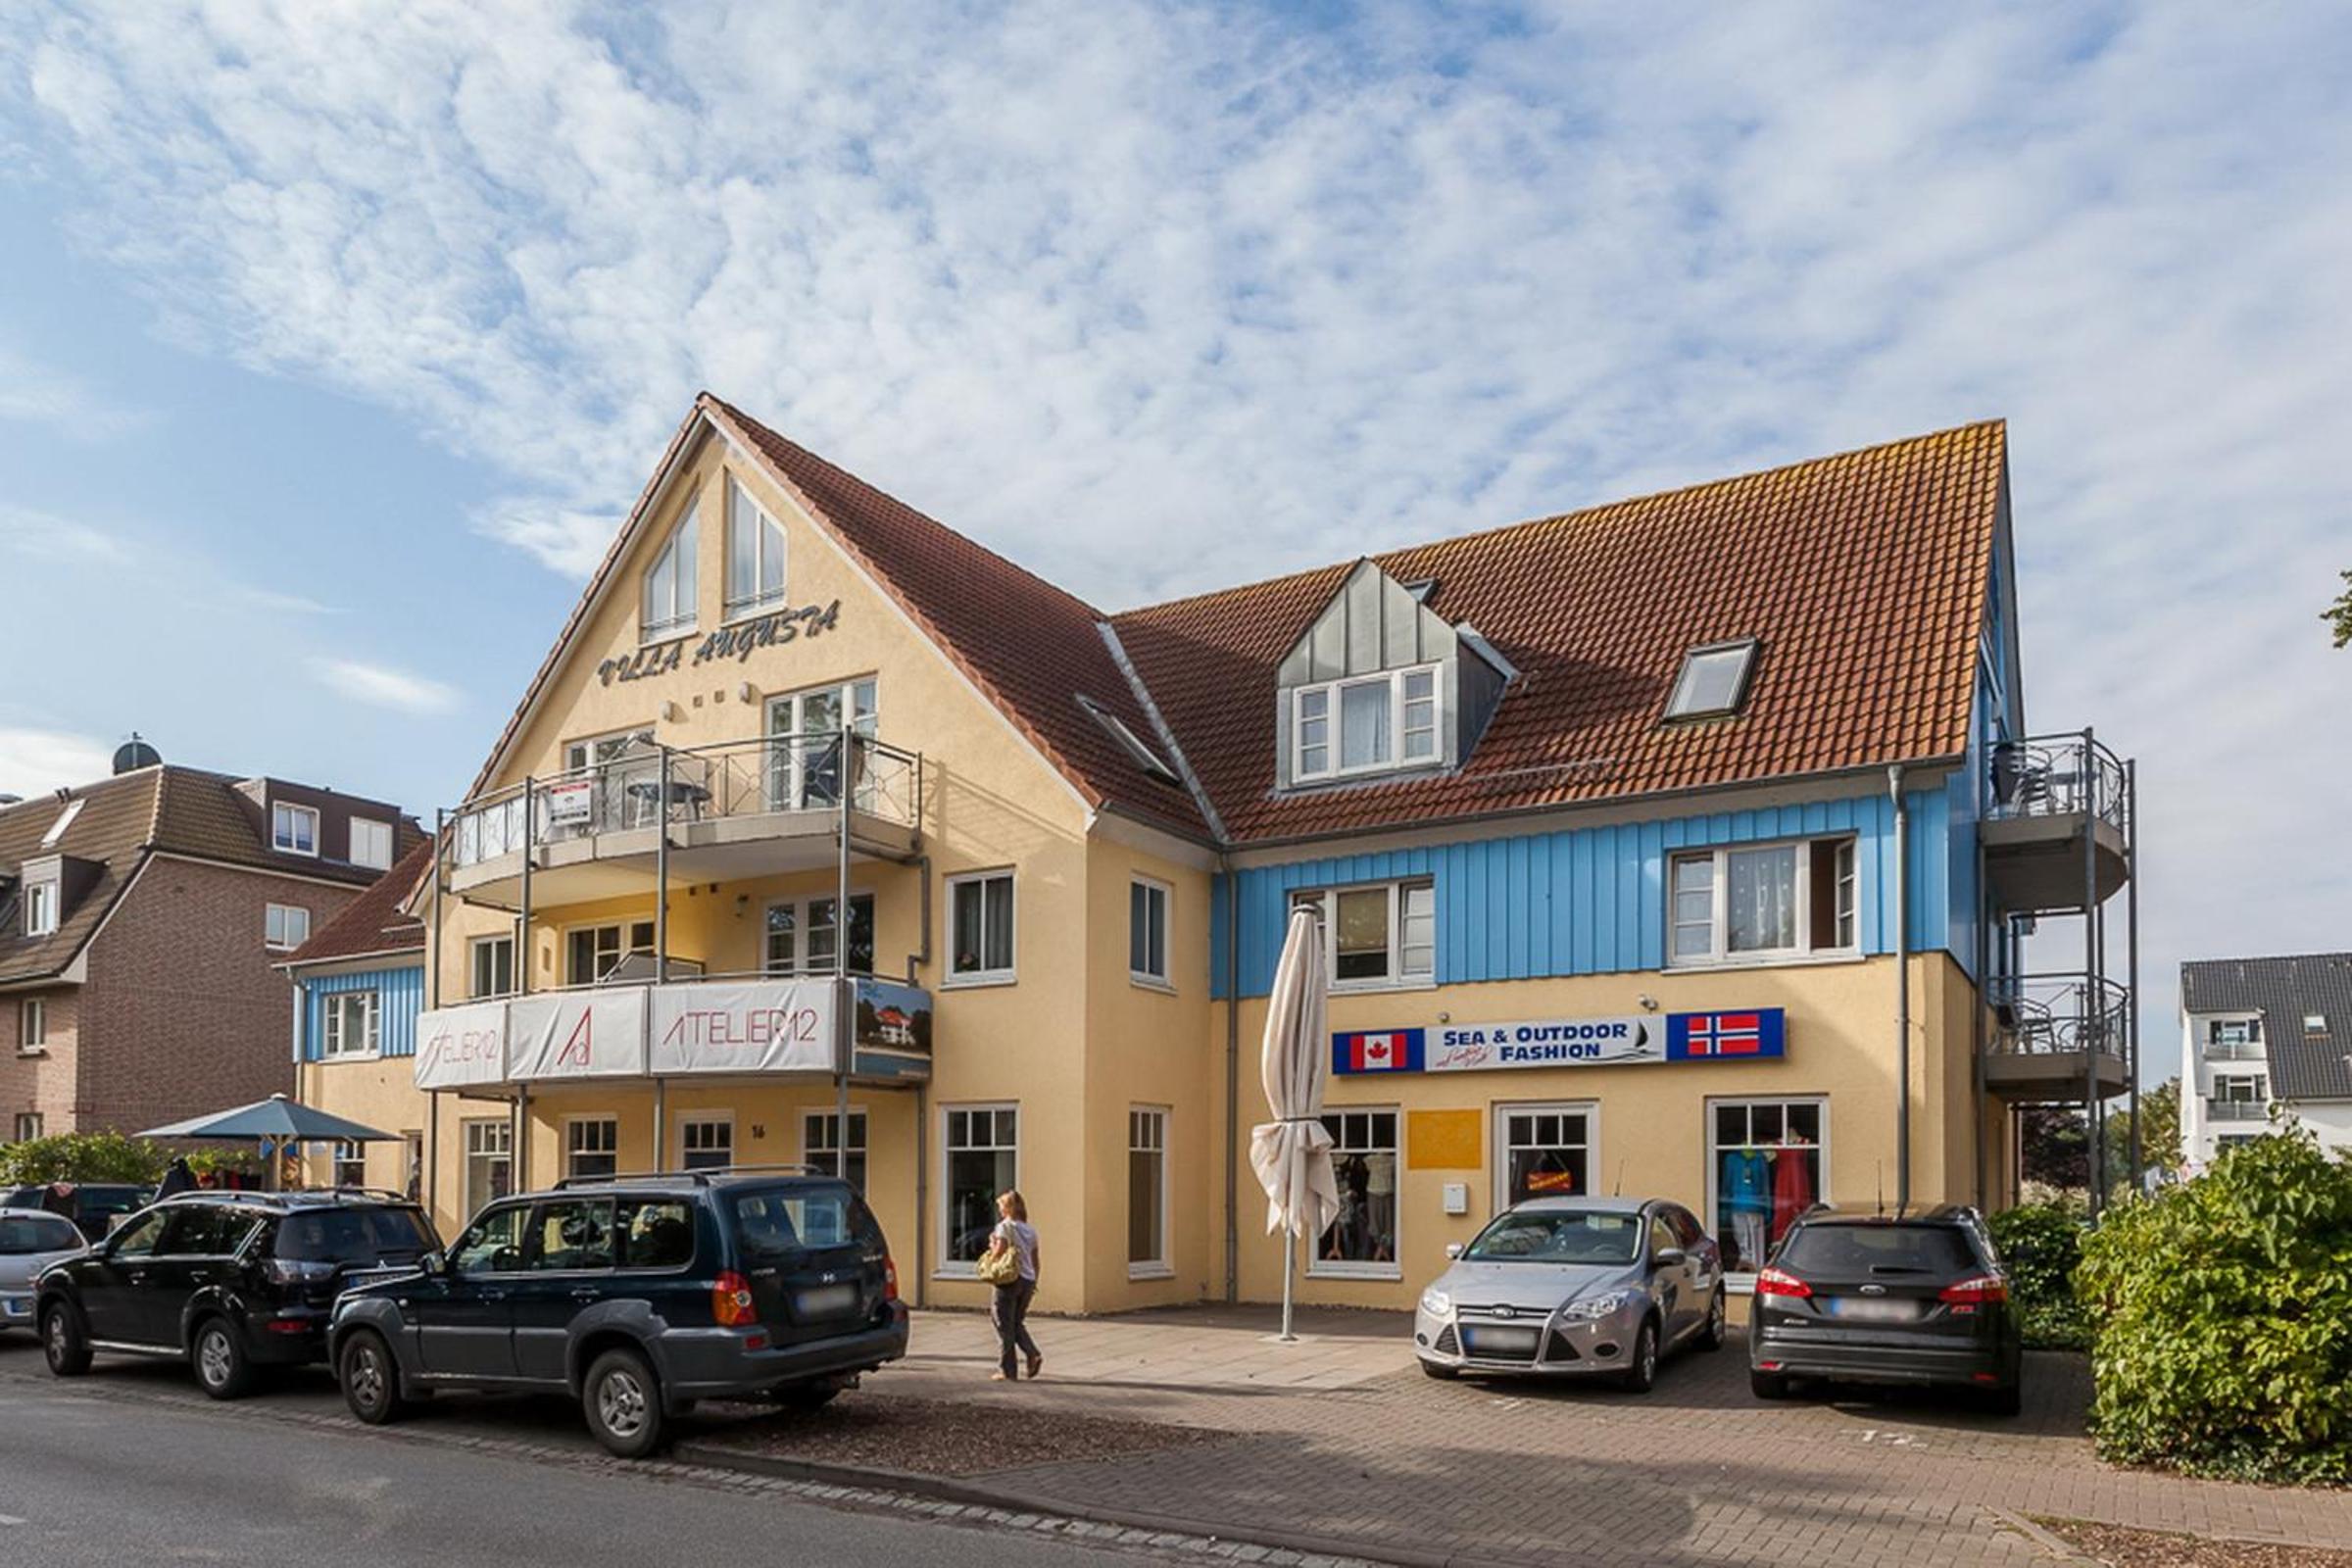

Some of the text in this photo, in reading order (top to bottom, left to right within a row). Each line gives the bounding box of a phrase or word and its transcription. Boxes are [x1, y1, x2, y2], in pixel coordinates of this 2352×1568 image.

[598, 599, 841, 687] VILLA AUGUSTA
[1444, 1023, 1628, 1047] SEA & OUTDOOR
[1500, 1043, 1600, 1061] FASHION
